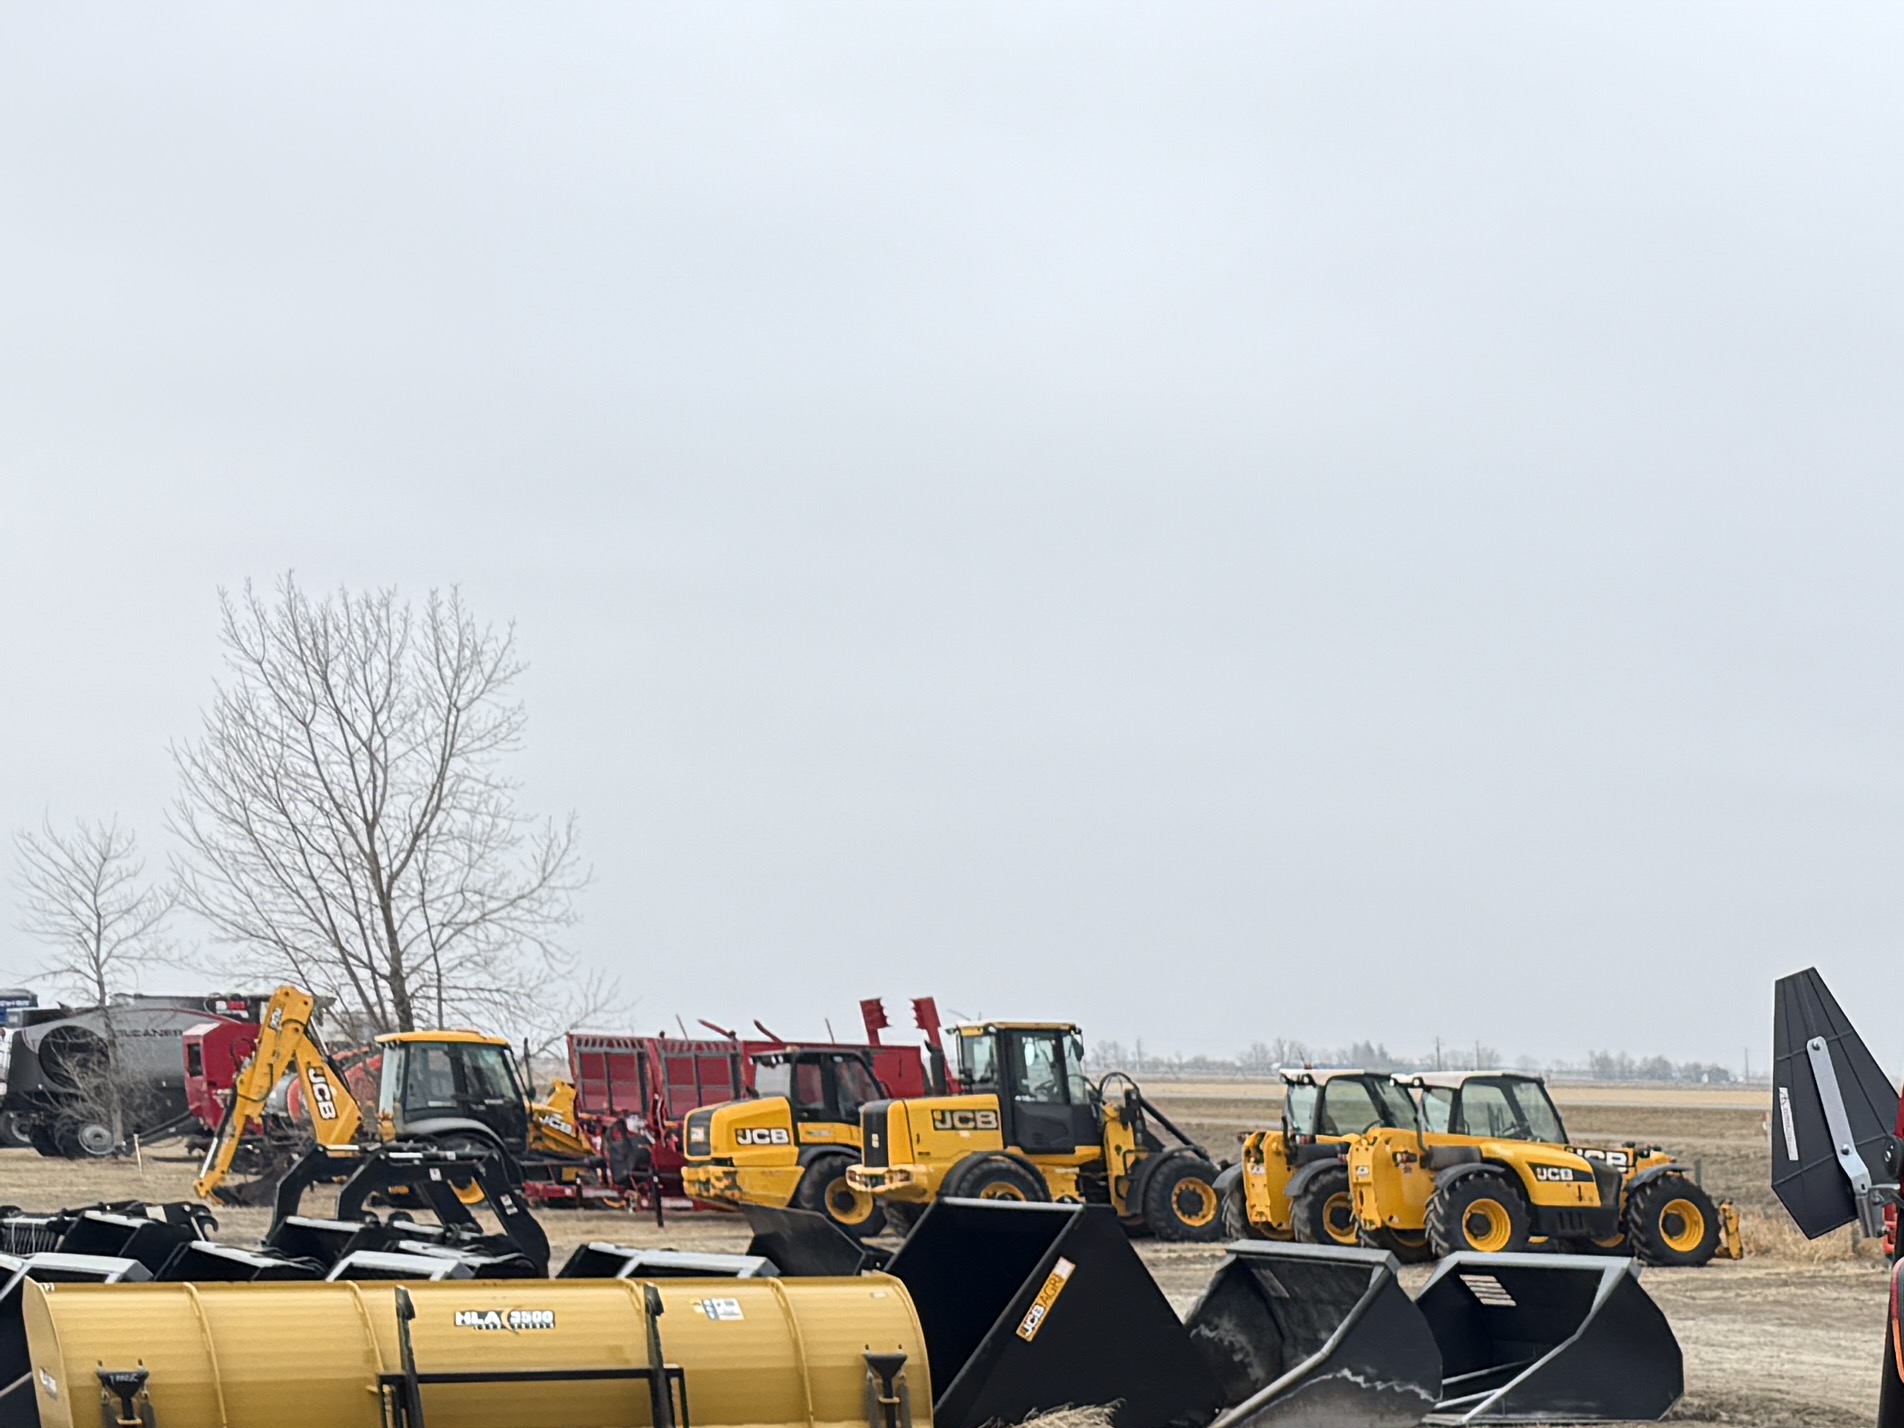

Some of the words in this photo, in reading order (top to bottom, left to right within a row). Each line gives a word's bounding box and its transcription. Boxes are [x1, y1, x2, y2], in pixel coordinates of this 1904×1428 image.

[308, 1067, 338, 1120] JCB
[933, 1109, 998, 1129] JCB
[736, 1129, 790, 1145] JCB
[1536, 1167, 1574, 1181] JCB
[1020, 1304, 1045, 1337] JCB
[1040, 1273, 1065, 1306] AGRI
[455, 1311, 501, 1326] HLA
